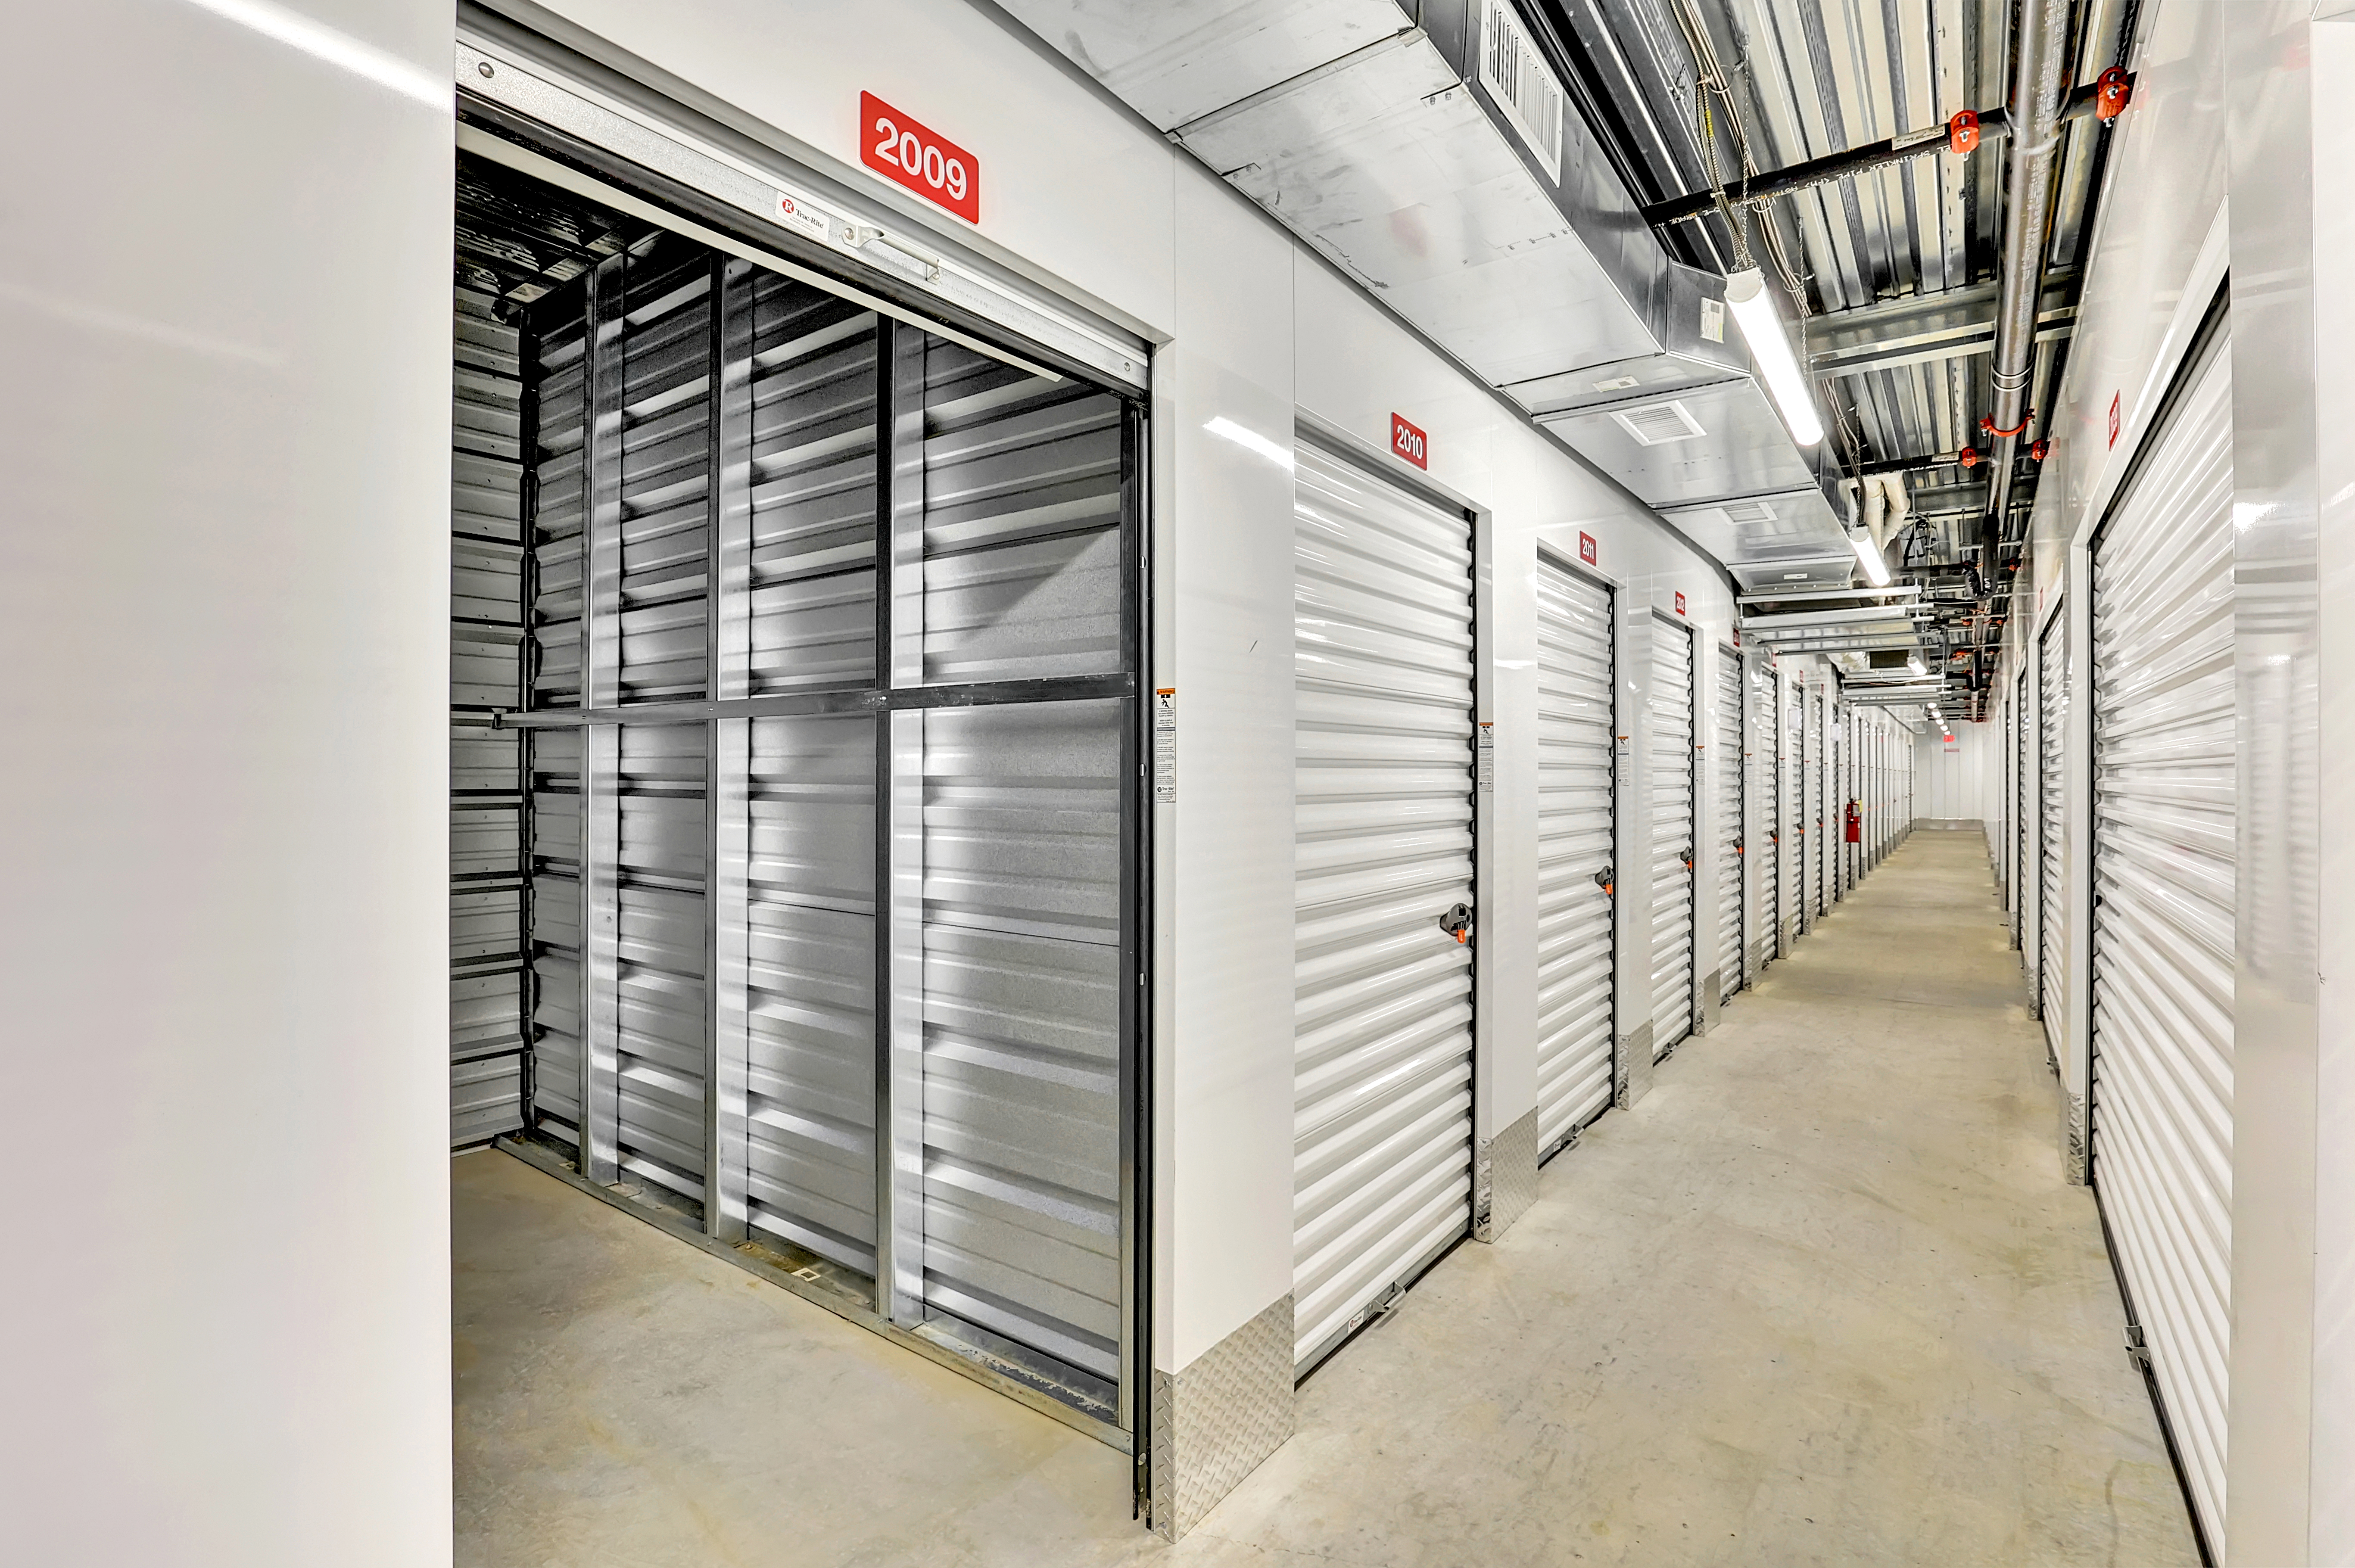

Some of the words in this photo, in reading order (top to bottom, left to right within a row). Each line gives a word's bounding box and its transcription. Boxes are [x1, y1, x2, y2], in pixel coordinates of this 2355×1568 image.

[1936, 144, 1951, 152] EL
[875, 117, 967, 201] 2009
[1868, 150, 1931, 171] SPRINKLER
[1835, 168, 1863, 180] PIPE
[1397, 424, 1423, 460] 2010
[1582, 538, 1594, 560] 2011
